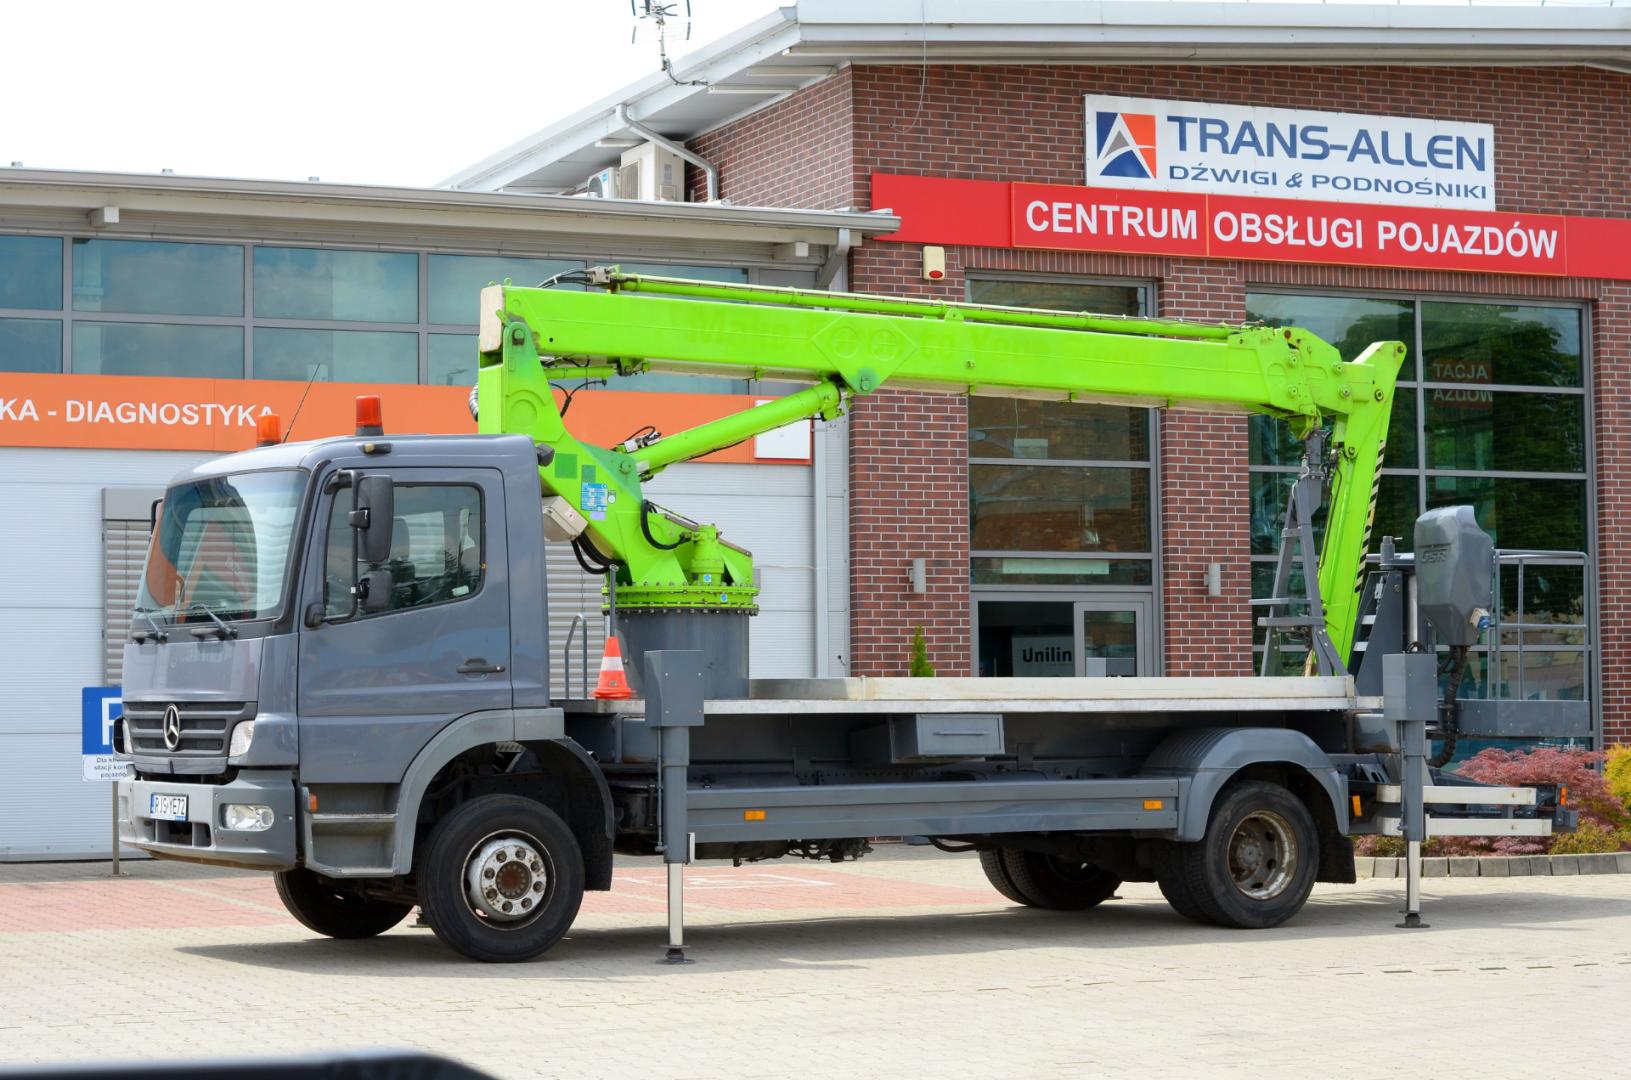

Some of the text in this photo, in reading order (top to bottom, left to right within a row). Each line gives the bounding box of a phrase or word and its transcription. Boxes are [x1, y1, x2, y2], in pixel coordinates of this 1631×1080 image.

[1167, 115, 1486, 171] TRANS-ALLEN
[1169, 162, 1487, 199] DŹWIGI & PODNOŚNIKI
[1025, 200, 1558, 259] CENTRUM OBSŁUGI POJAZDÓW
